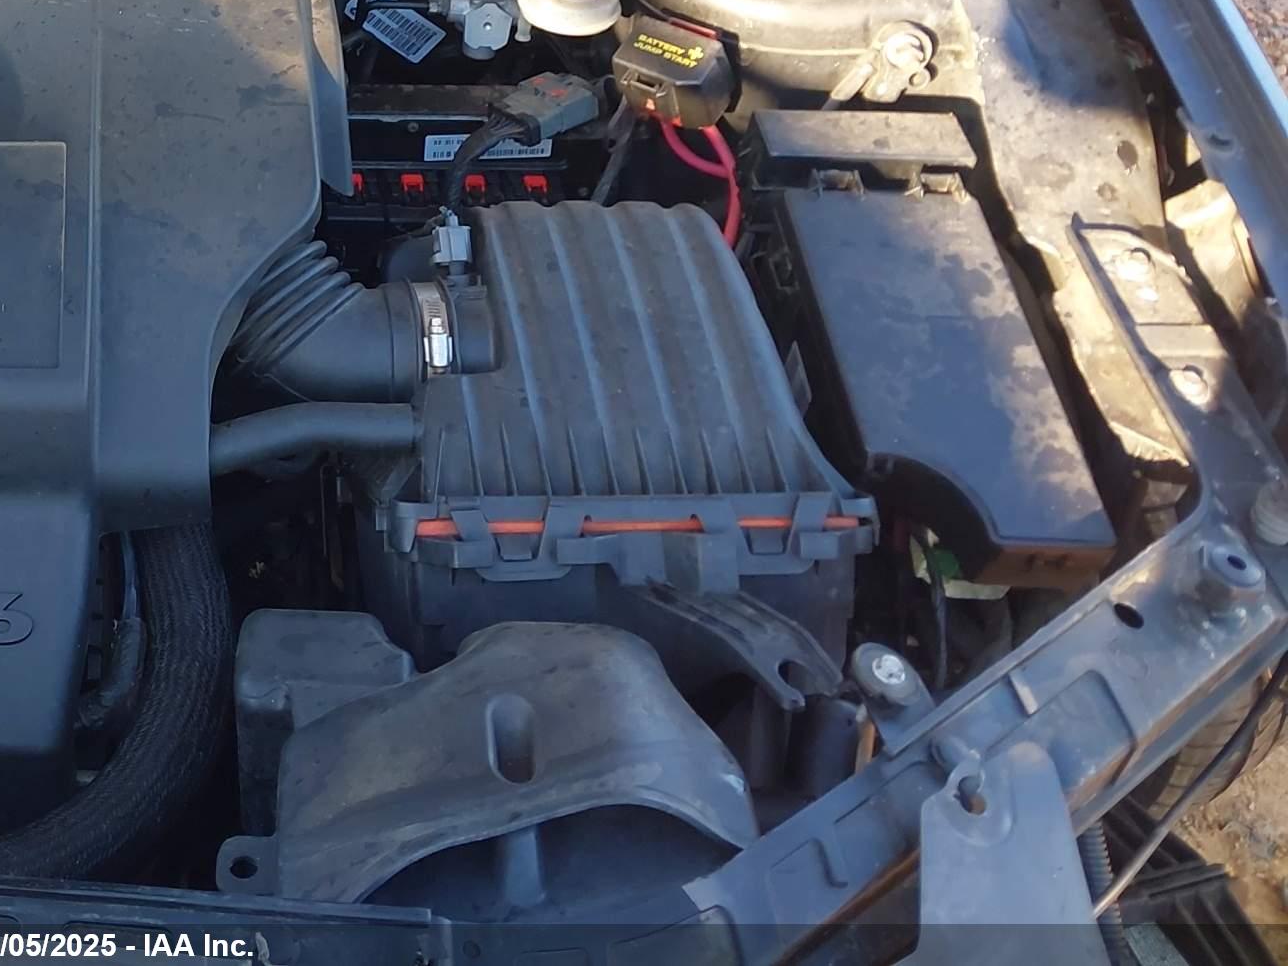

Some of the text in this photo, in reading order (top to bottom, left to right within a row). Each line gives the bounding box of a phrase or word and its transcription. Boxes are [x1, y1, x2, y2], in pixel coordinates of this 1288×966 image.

[633, 41, 698, 67] JUMP START
[638, 33, 685, 55] BATTERY
